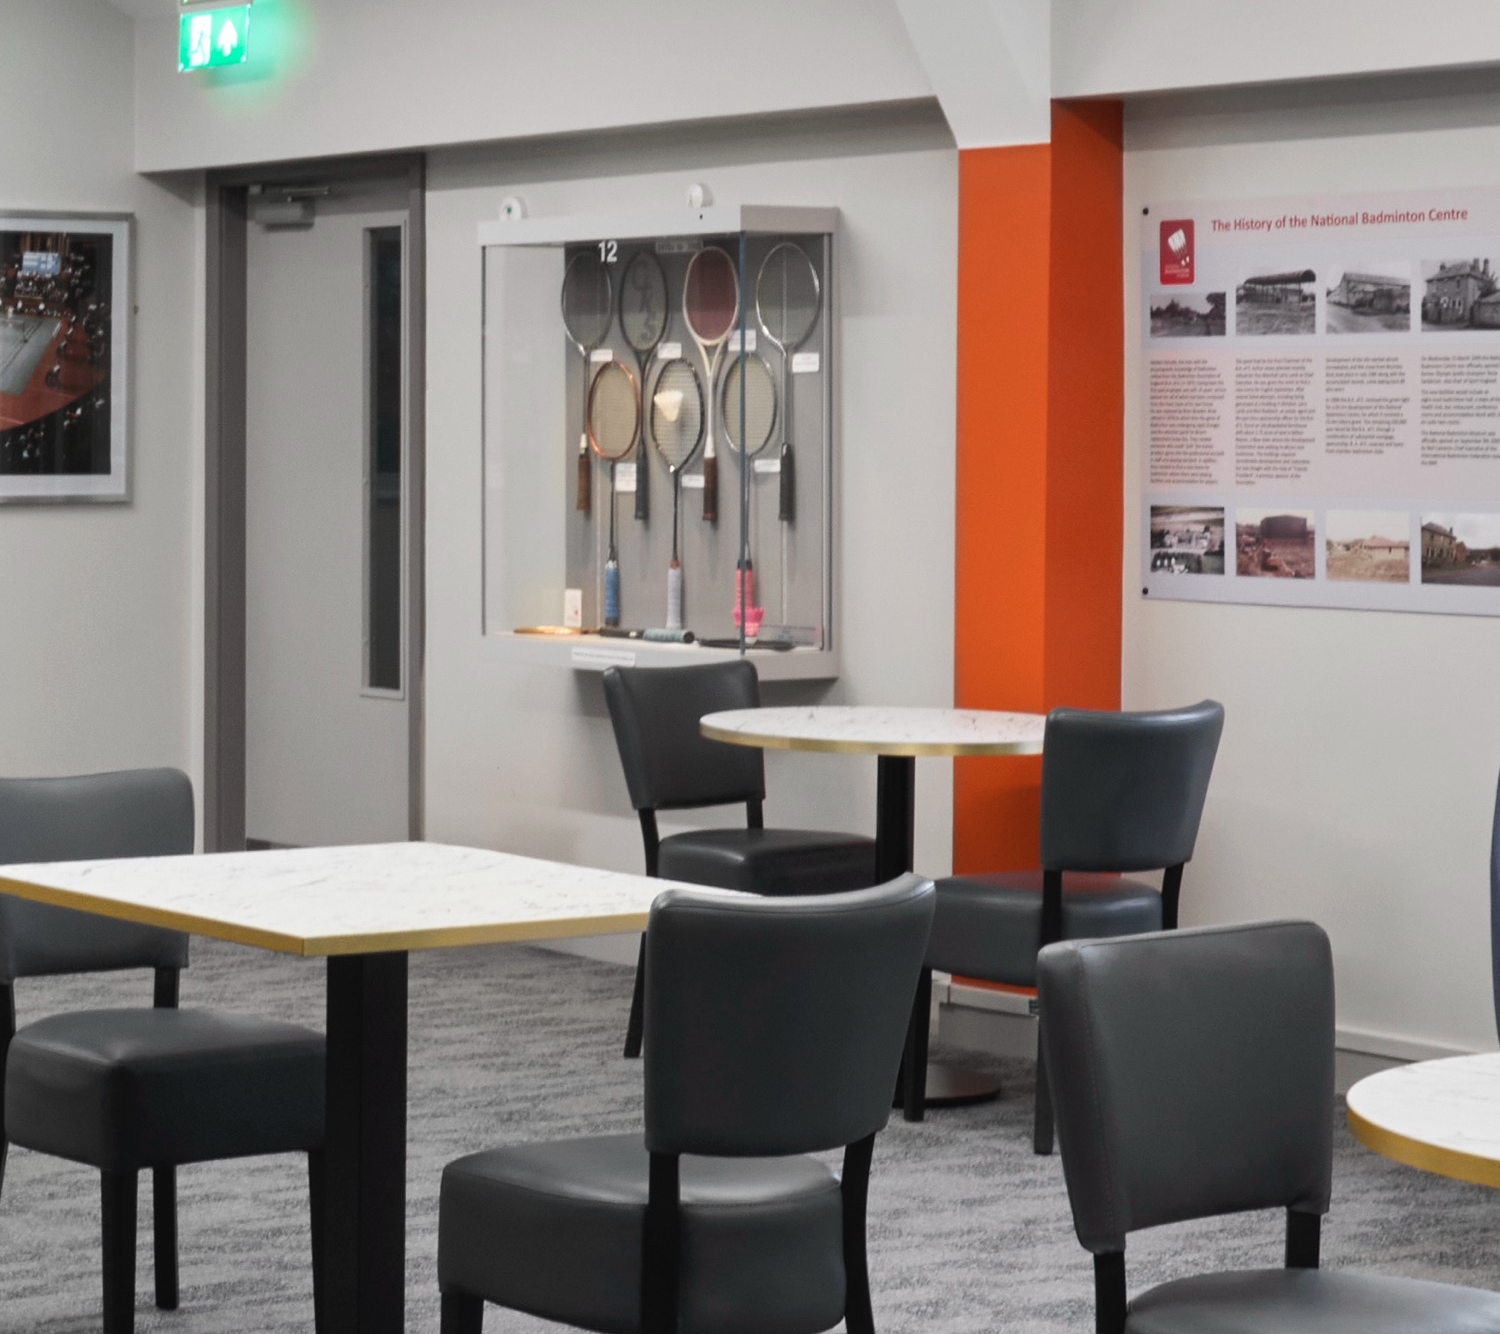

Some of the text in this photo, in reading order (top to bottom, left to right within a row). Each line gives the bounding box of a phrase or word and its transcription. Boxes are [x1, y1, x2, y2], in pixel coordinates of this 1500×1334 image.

[1211, 208, 1469, 232] The History of the National Badminton Centre
[598, 239, 618, 263] 12
